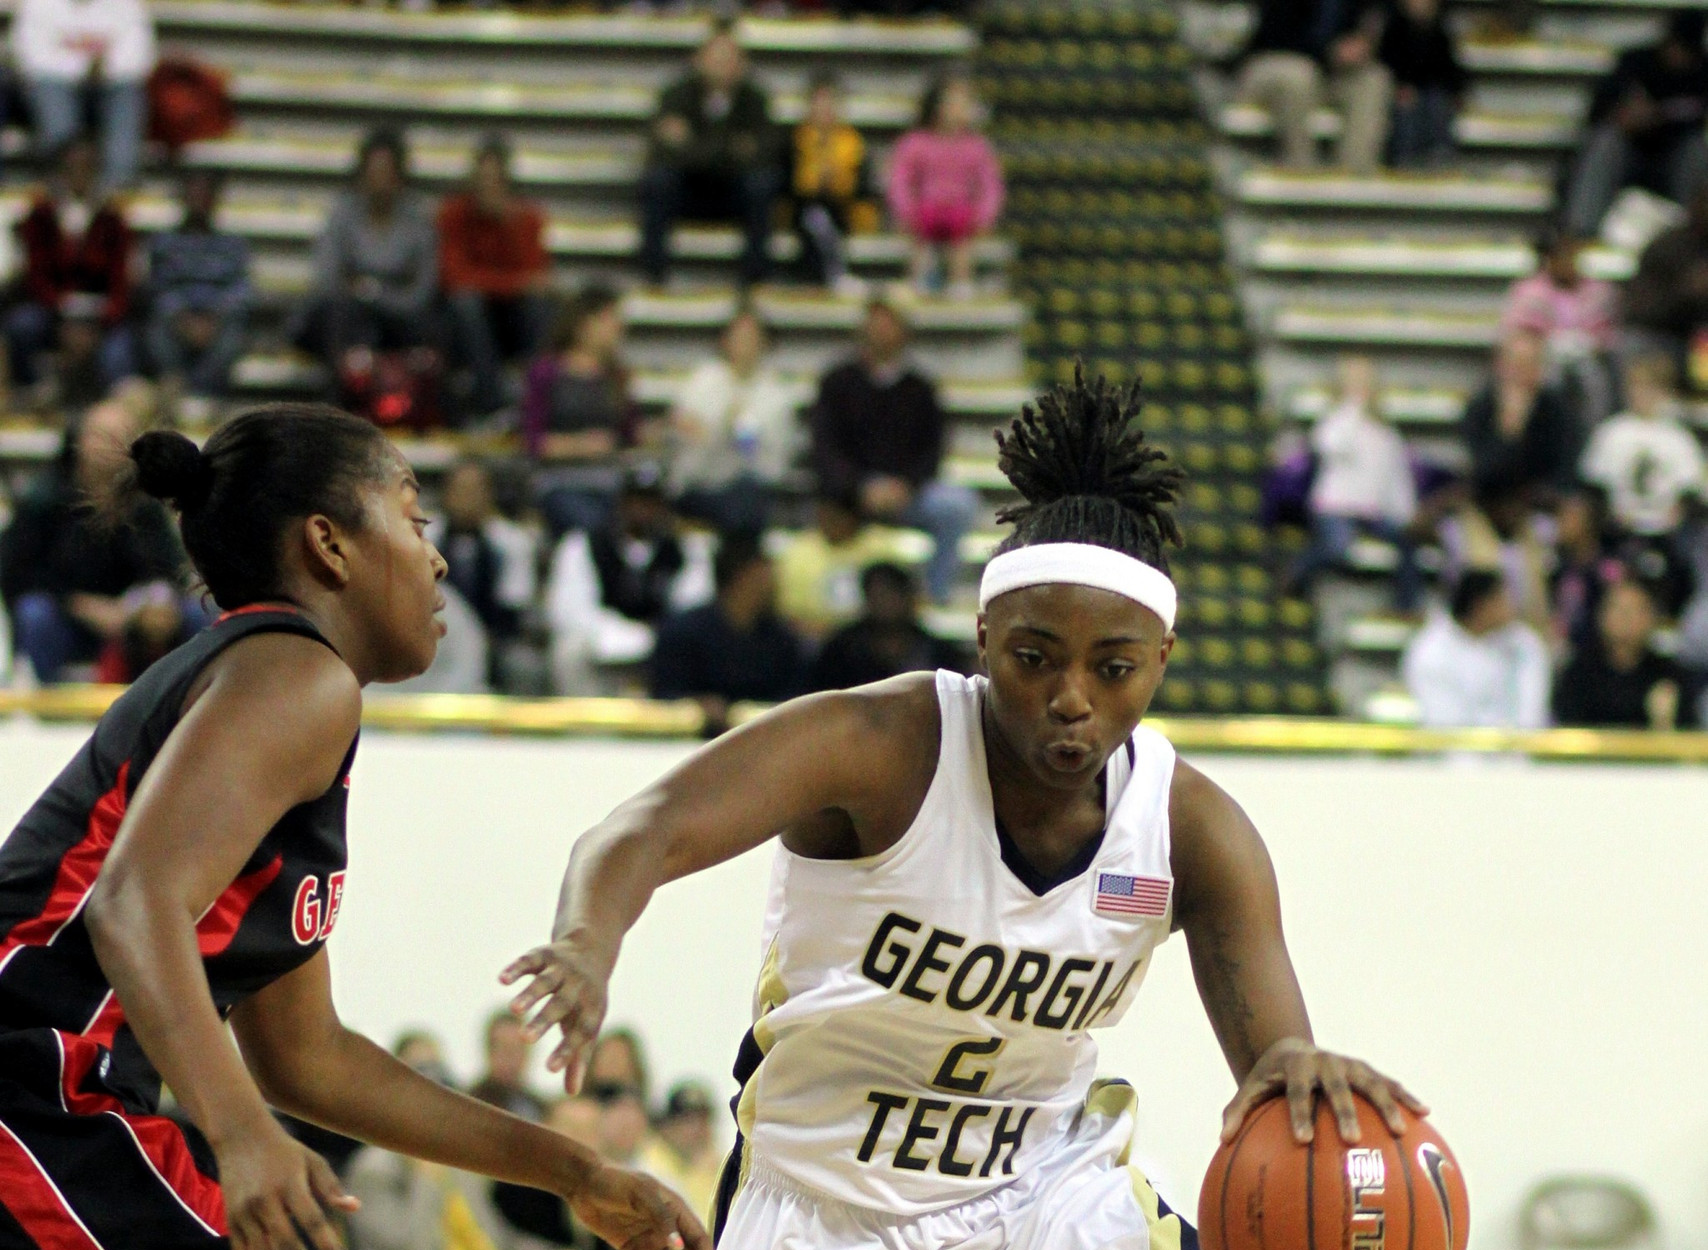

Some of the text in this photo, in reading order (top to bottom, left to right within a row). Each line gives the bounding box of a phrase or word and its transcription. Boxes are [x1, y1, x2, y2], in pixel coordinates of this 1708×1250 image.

[861, 912, 1142, 1031] GEORGIA
[931, 1036, 1004, 1093] 2
[856, 1091, 1038, 1178] TECH
